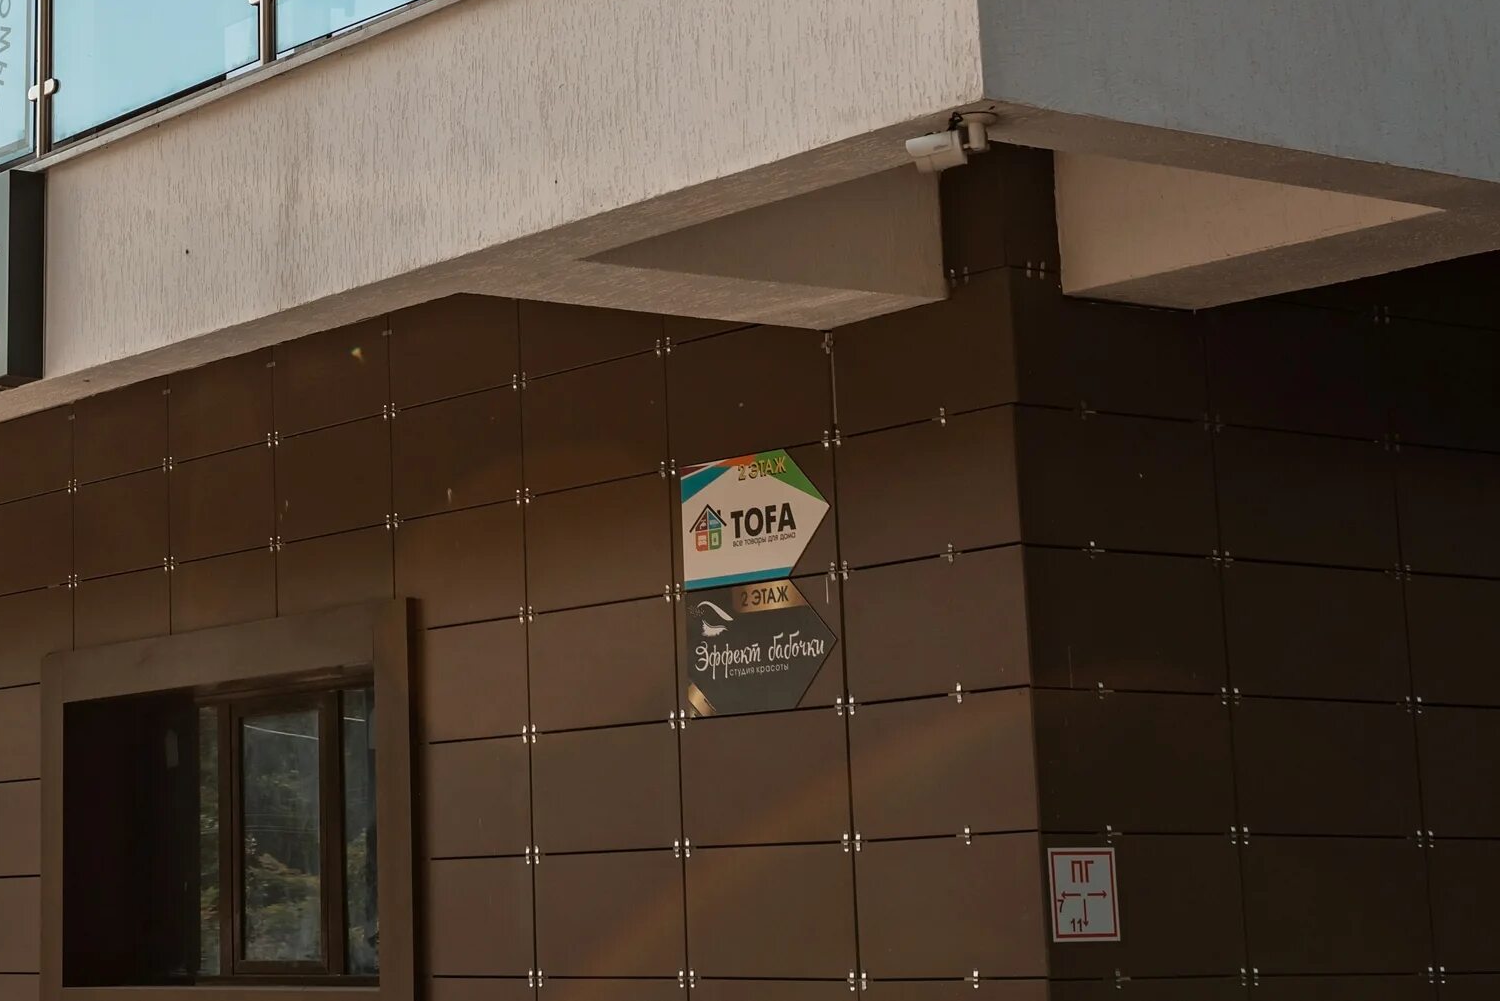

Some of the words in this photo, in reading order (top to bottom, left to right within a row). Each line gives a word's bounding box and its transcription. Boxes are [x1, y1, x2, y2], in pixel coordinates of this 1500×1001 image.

[737, 464, 746, 481] 2
[748, 456, 787, 479] ЭТАЖ
[730, 502, 797, 539] TOFA
[741, 591, 748, 606] 2
[751, 586, 789, 606] ЭТАЖ
[695, 641, 761, 680] Эффект
[768, 630, 825, 661] бабочки
[729, 667, 755, 677] студия
[756, 663, 790, 675] красоты
[1071, 861, 1094, 883] ПГ
[1057, 899, 1064, 913] 7
[1070, 918, 1083, 932] 11
